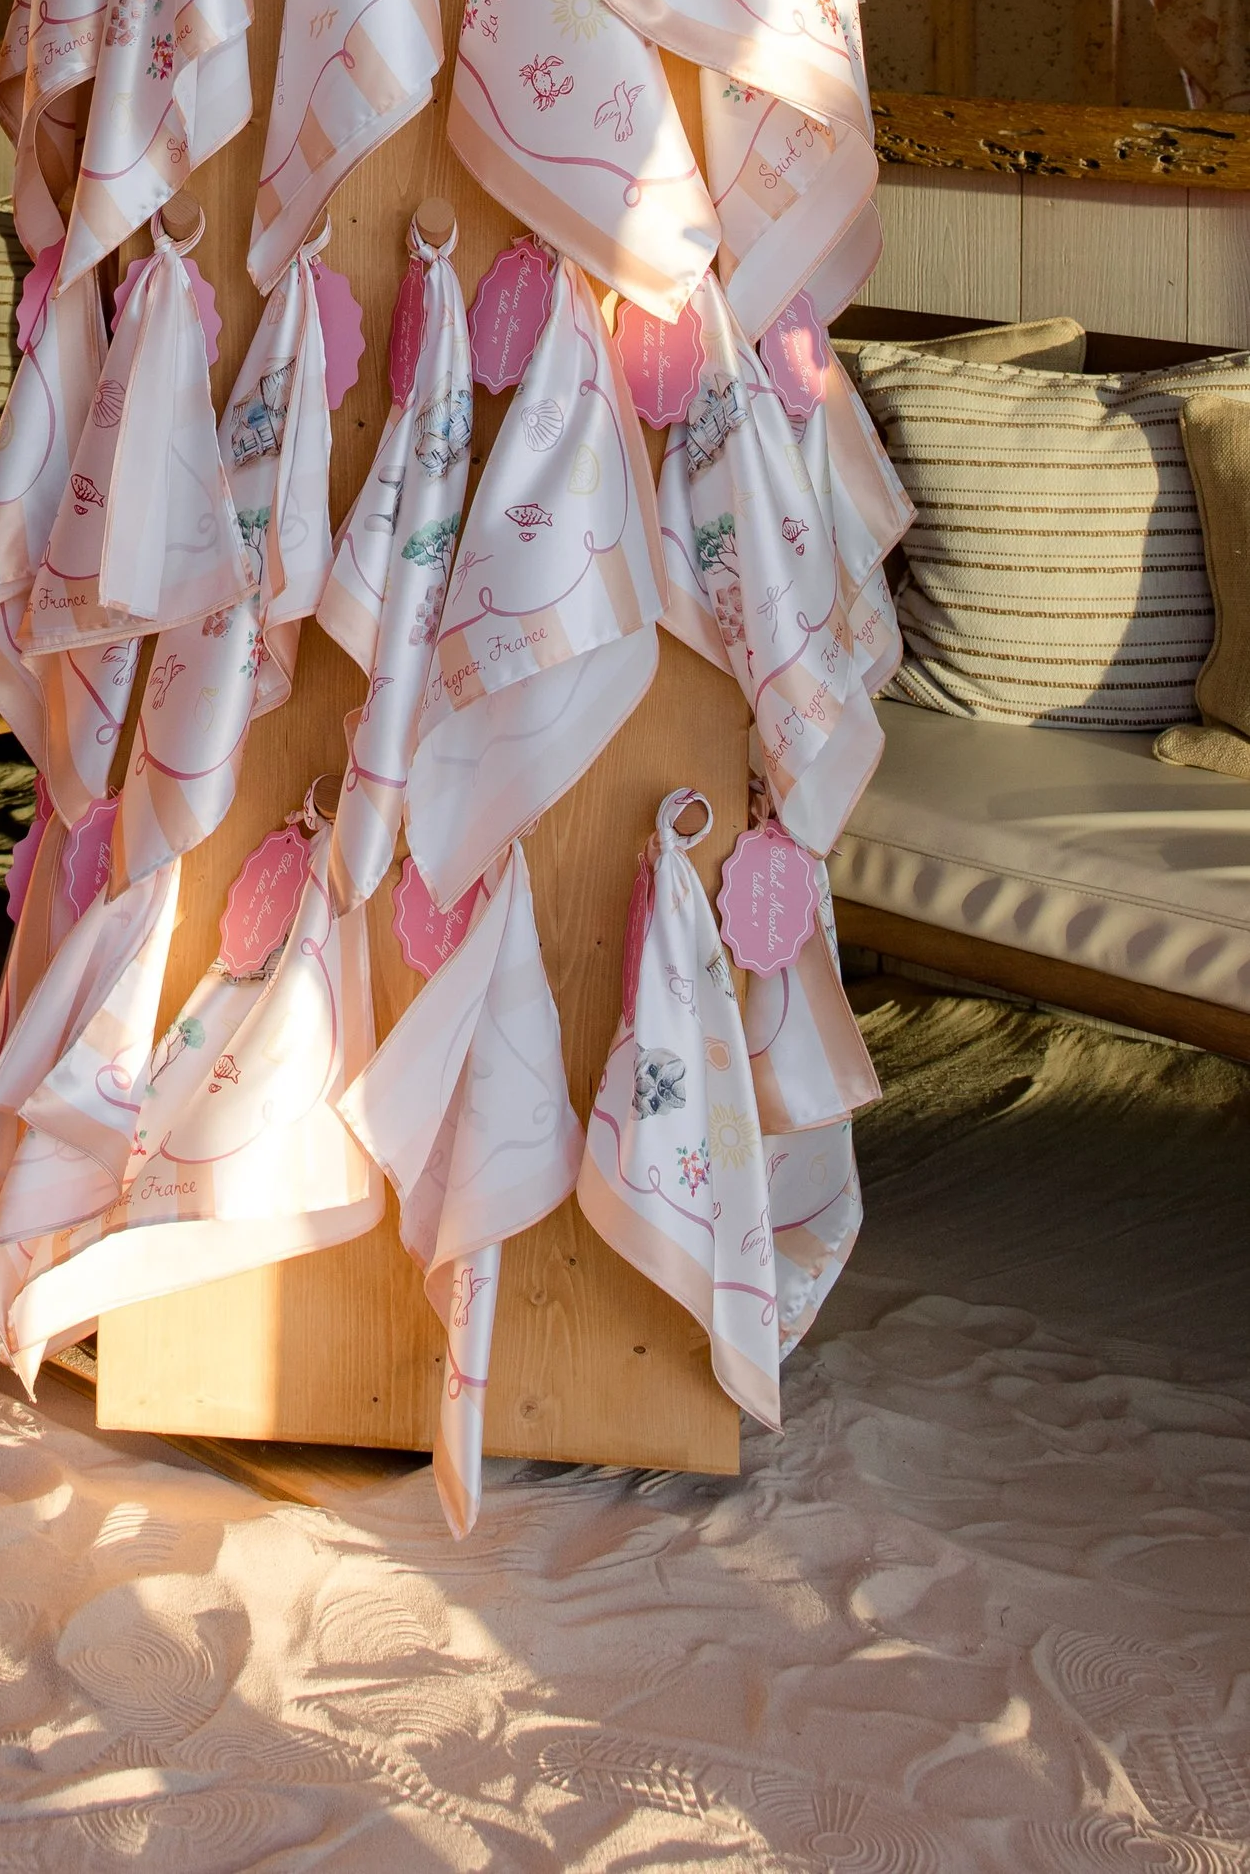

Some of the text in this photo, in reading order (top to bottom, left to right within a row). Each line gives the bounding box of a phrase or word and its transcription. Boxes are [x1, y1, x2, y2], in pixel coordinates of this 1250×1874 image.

[480, 14, 499, 44] La
[42, 31, 95, 65] France
[758, 136, 802, 189] Saint
[497, 288, 510, 314] table
[498, 255, 532, 381] Adrian Lawrence
[643, 320, 655, 347] table
[777, 320, 789, 346] table
[657, 351, 671, 414] Lawrence
[39, 587, 89, 610] France
[853, 607, 886, 645] ropez,
[431, 628, 549, 701] Tropez, France
[765, 724, 793, 772] Saint
[783, 679, 833, 736] Tropez,
[98, 842, 110, 869] table
[254, 868, 271, 895] table
[752, 872, 765, 898] table
[768, 845, 787, 952] Elliot Martin
[244, 852, 295, 950] Chris Lumley
[435, 909, 464, 961] Lumley
[140, 1175, 197, 1200] France
